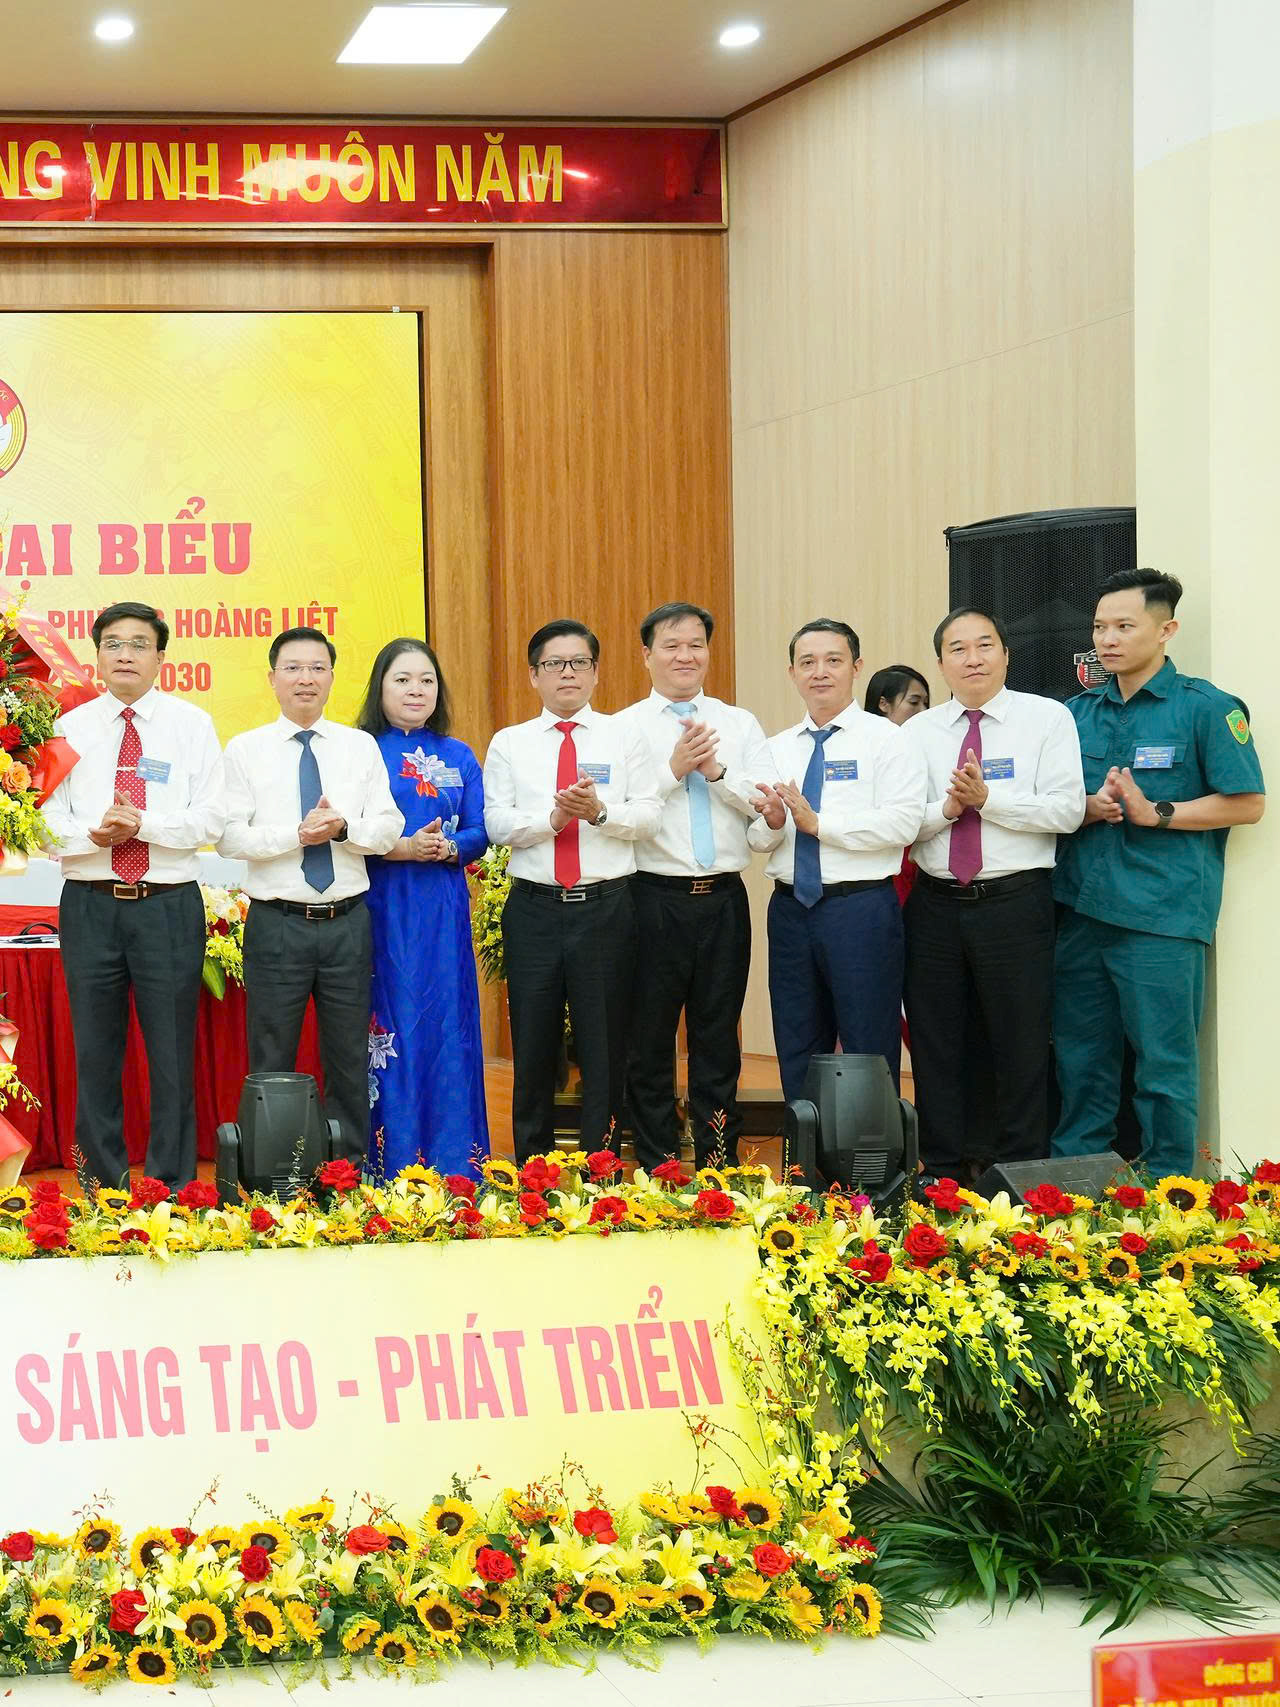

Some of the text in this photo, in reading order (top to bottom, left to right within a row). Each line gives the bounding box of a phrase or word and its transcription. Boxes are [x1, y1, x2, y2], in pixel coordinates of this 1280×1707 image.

[83, 142, 219, 200] VINH
[242, 131, 416, 203] MUÔN
[436, 132, 563, 203] NĂM
[98, 496, 252, 576] BIỂU
[176, 602, 272, 638] HOÀNG
[15, 1333, 185, 1445] SÁNG
[199, 1340, 319, 1453] TẠO
[338, 1380, 359, 1397] -
[375, 1313, 528, 1423] PHÁT
[542, 1285, 724, 1414] TRIỂN
